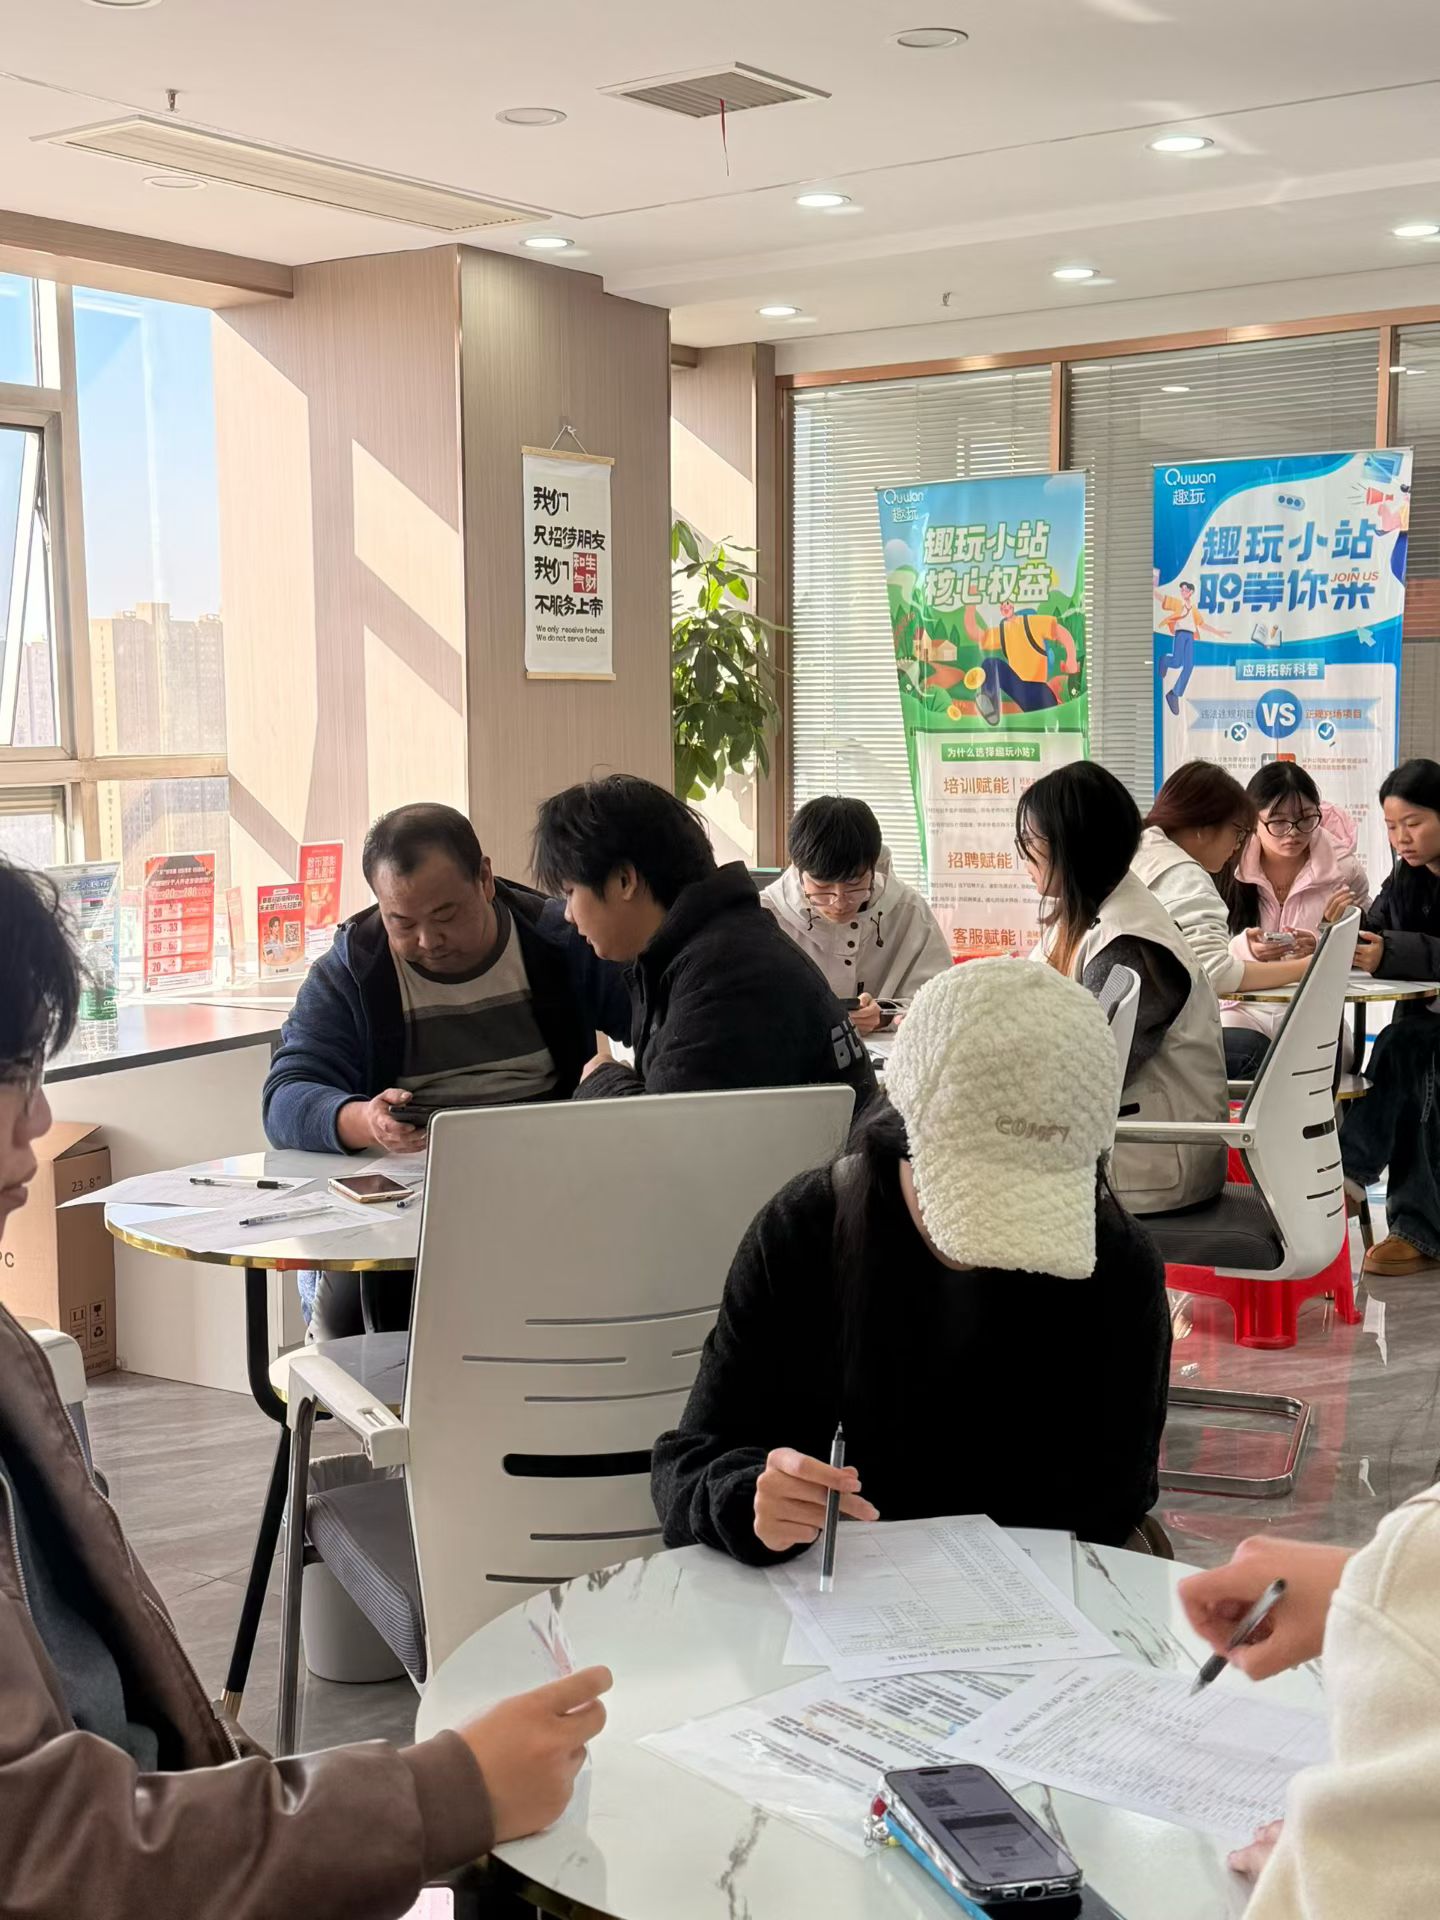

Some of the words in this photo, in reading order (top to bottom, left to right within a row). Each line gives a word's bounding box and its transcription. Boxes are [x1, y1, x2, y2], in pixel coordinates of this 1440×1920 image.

[1164, 467, 1216, 486] Quwan
[533, 487, 569, 516] 我们
[883, 488, 924, 505] Quwan
[1172, 488, 1205, 506] 趣玩
[892, 507, 918, 523] 趣玩
[533, 525, 606, 551] 只招待朋友
[923, 520, 1051, 564] 趣玩小站
[1200, 519, 1376, 566] 趣玩小站
[534, 556, 570, 585] 我们
[1331, 571, 1360, 583] JOIN
[1362, 570, 1379, 582] US
[923, 563, 1052, 606] 核心权益
[1198, 567, 1375, 614] 职等你来
[534, 594, 604, 618] 不服务上帝
[547, 625, 560, 634] only
[585, 626, 605, 634] friends
[1242, 663, 1319, 678] 应用拓新科普
[1262, 702, 1296, 727] VS
[944, 777, 1009, 794] 培训赋能
[948, 851, 1012, 869] 招聘赋能
[953, 928, 1016, 946] 客服赋能
